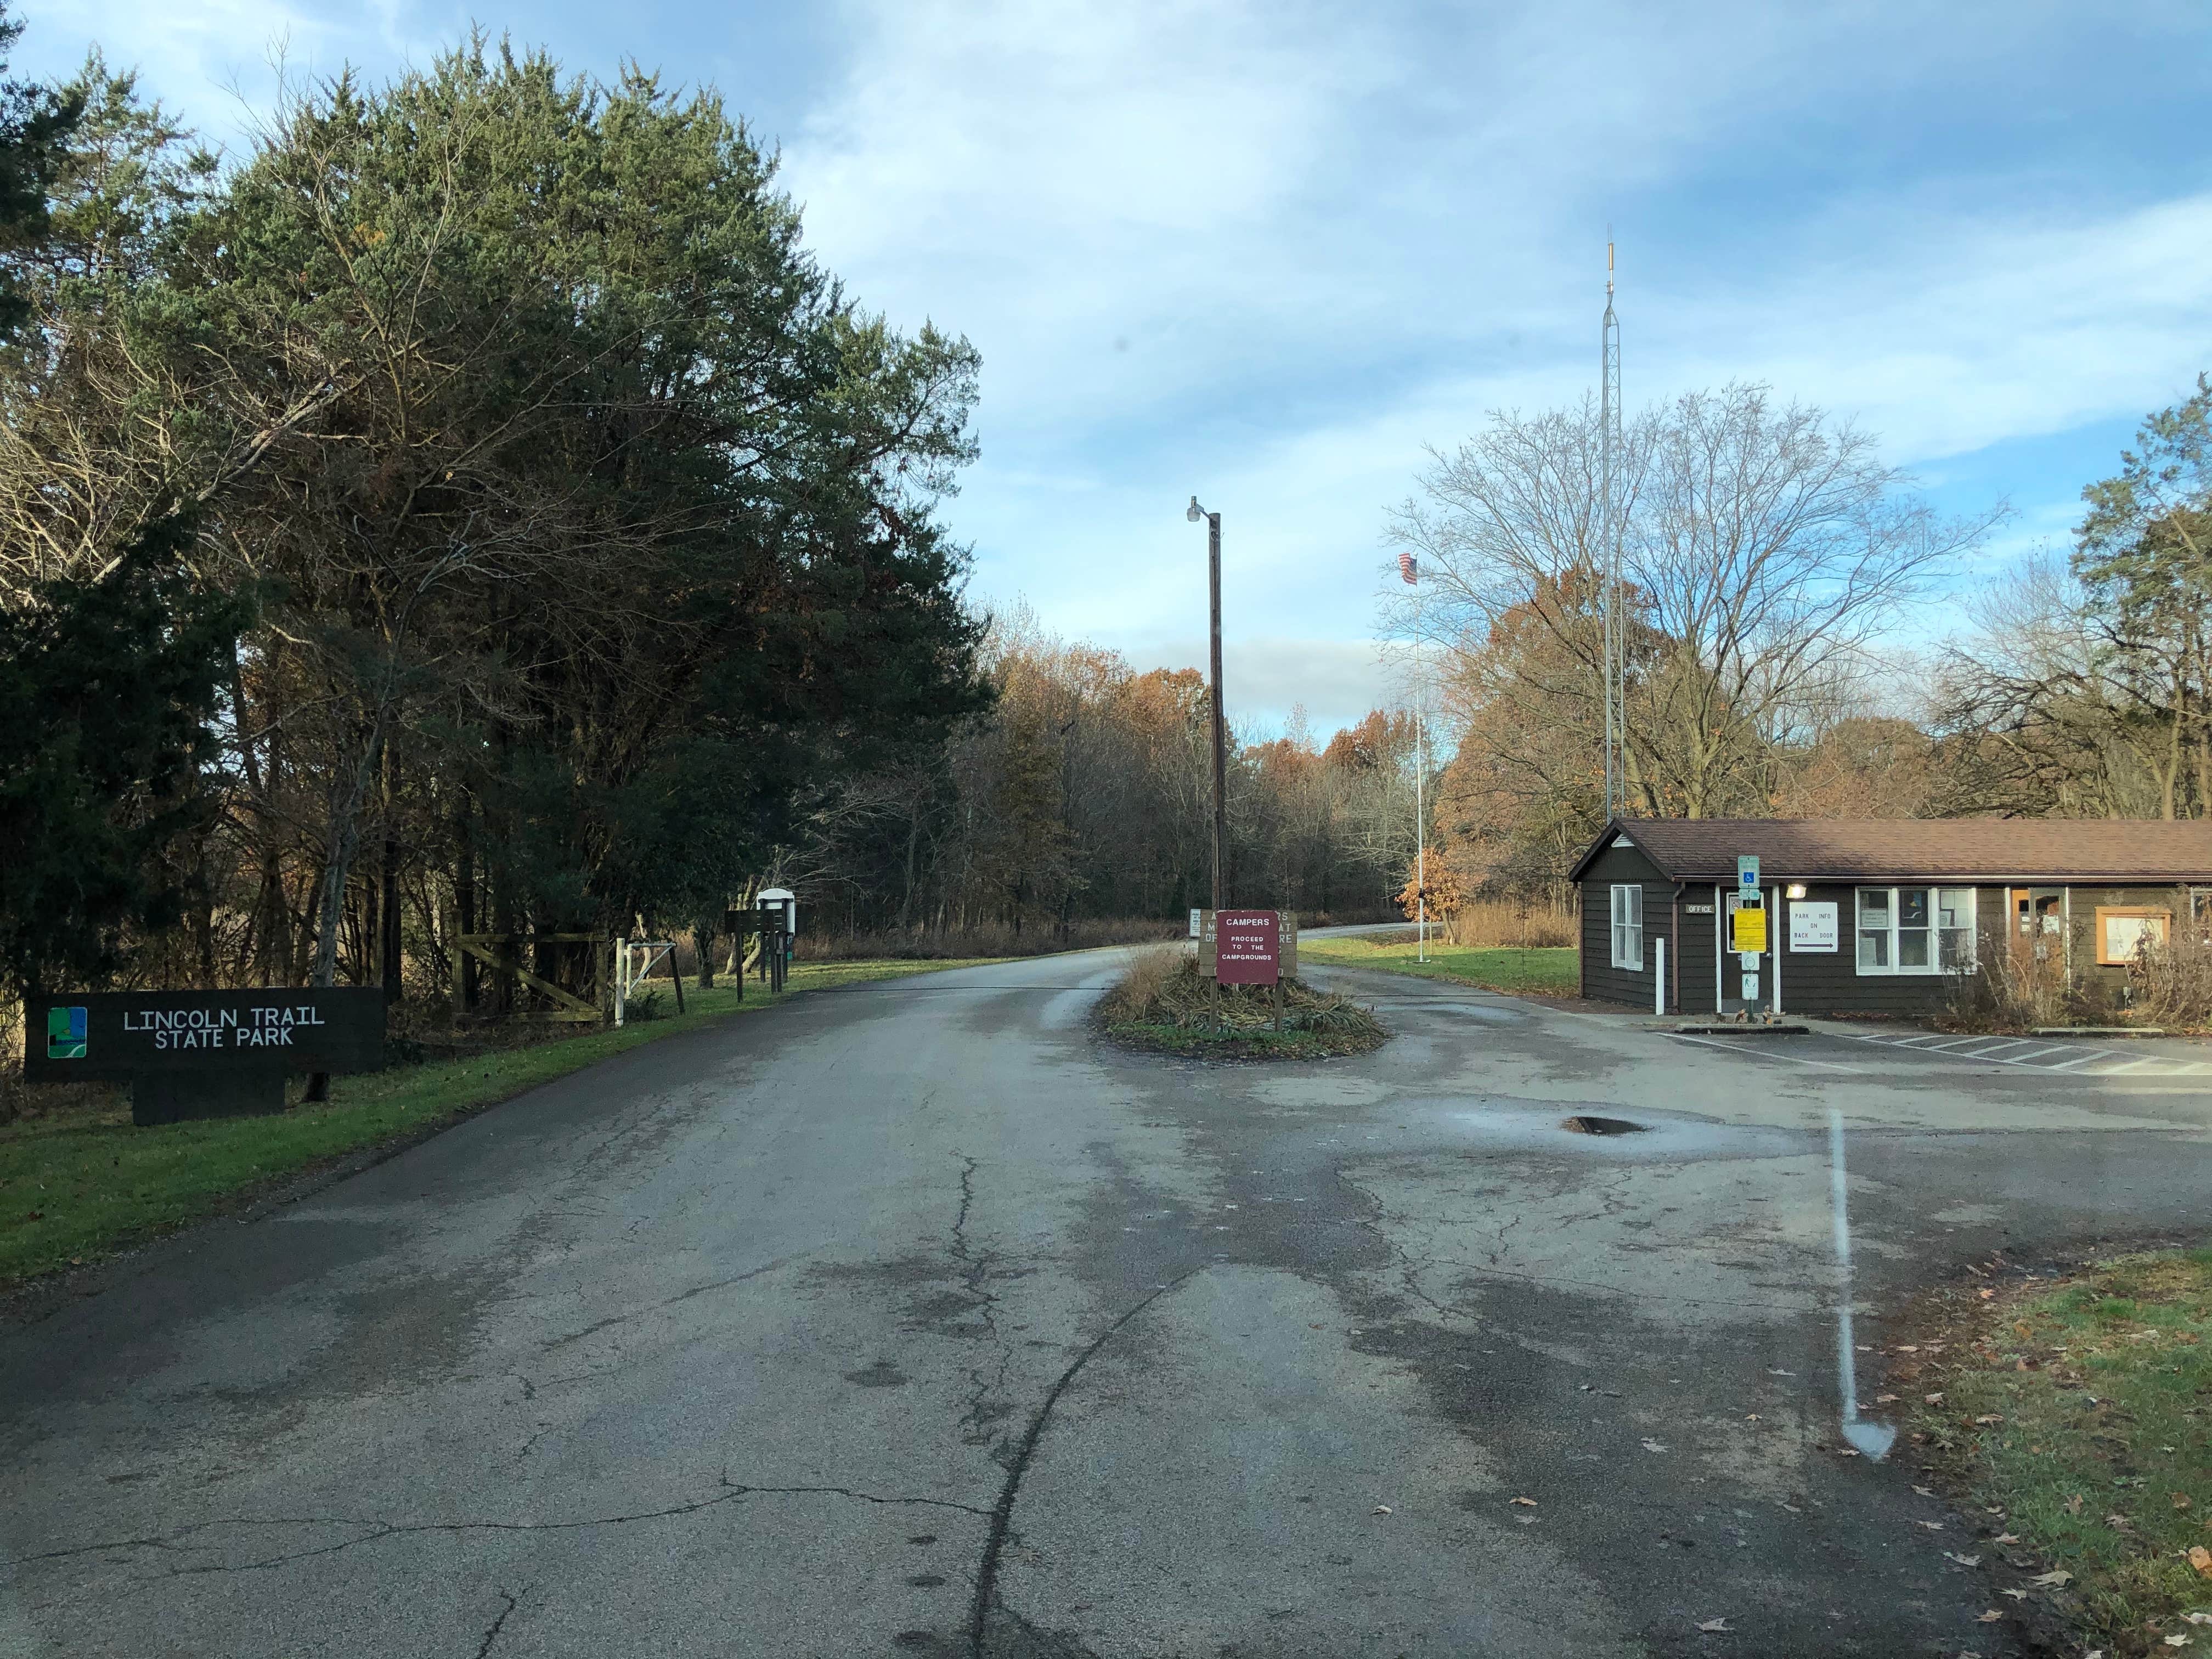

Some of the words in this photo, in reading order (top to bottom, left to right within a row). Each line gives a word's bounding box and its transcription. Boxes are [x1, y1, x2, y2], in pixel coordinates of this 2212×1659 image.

[124, 1009, 237, 1030] LINCOLN
[250, 1007, 325, 1026] TRAIL
[155, 1029, 224, 1049] STATE
[236, 1027, 294, 1047] PARK
